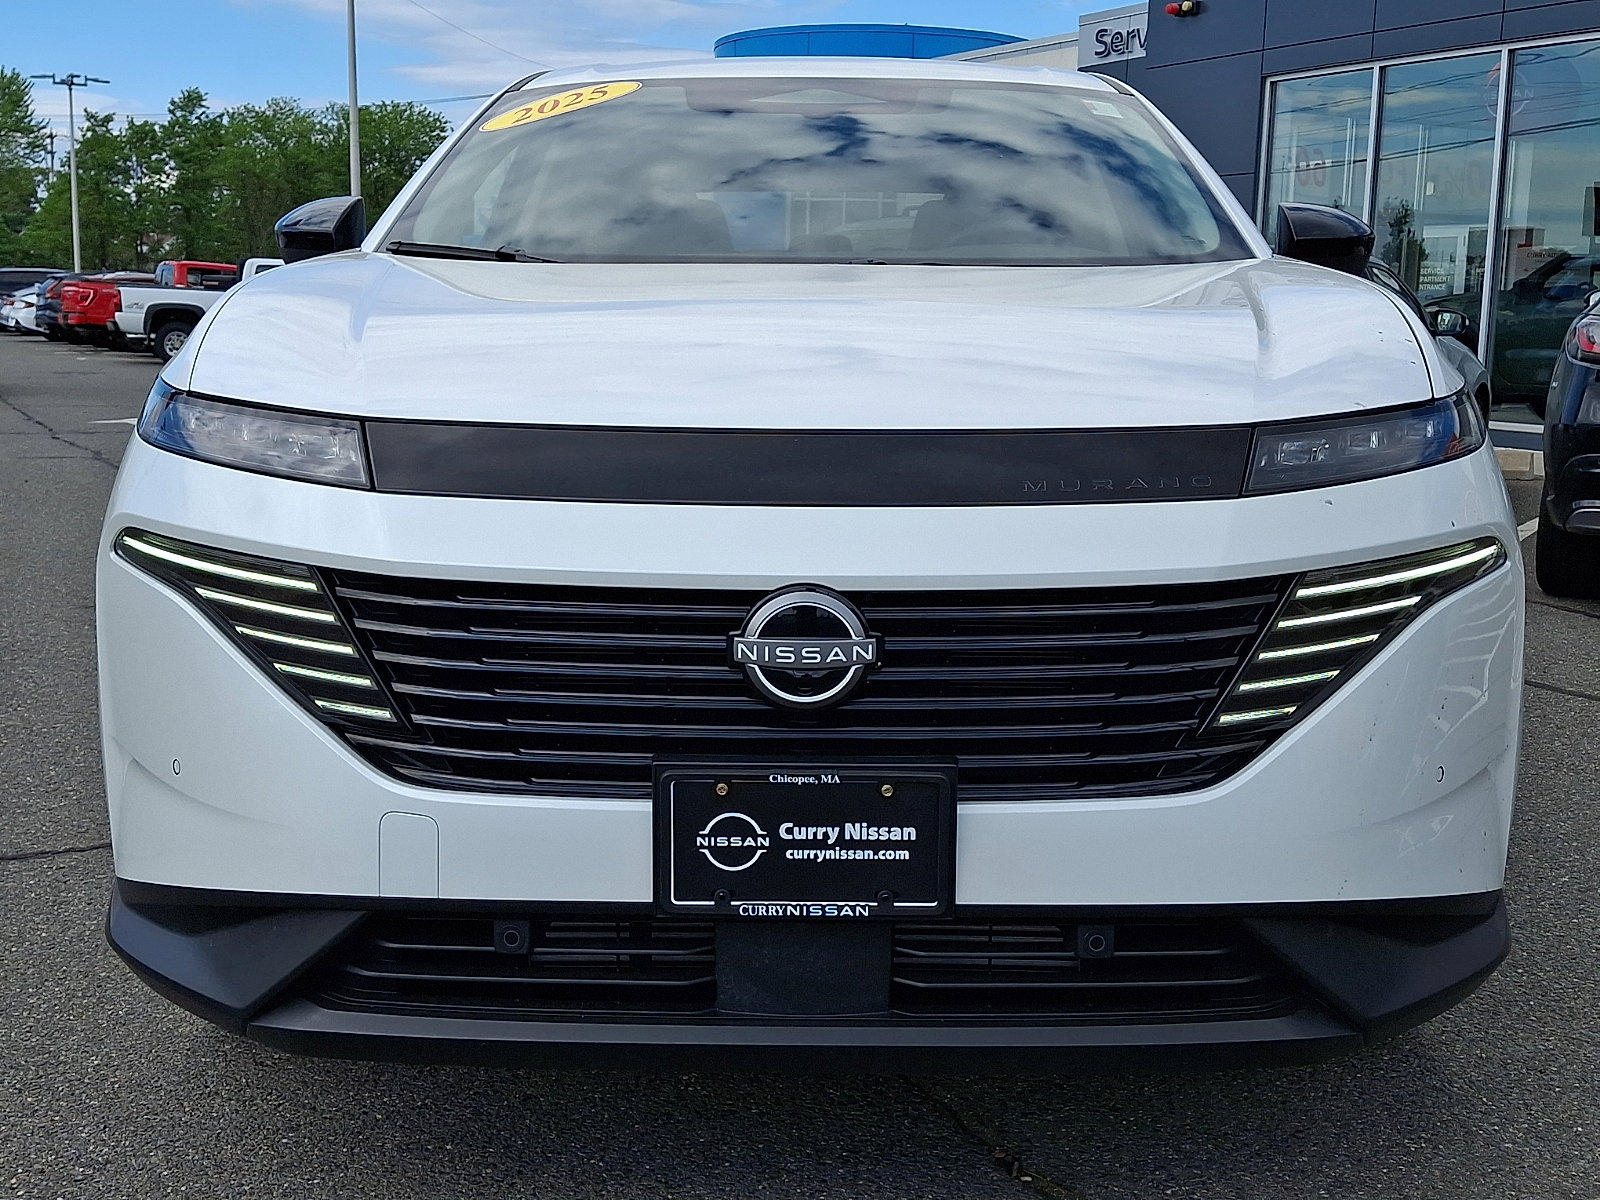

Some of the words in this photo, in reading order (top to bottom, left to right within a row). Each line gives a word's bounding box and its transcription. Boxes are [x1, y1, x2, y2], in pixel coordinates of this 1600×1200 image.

[511, 85, 609, 124] 2025
[1419, 275, 1451, 283] PARTMENT
[1418, 283, 1446, 291] NTRANCE
[1023, 475, 1212, 492] MURANO
[736, 642, 875, 665] NISSAN
[769, 774, 819, 785] Chicopee,
[820, 774, 841, 784] MA
[778, 822, 840, 845] Curry
[844, 823, 917, 841] Nissan
[696, 836, 770, 847] NISSAN
[785, 847, 910, 862] currynissan.com
